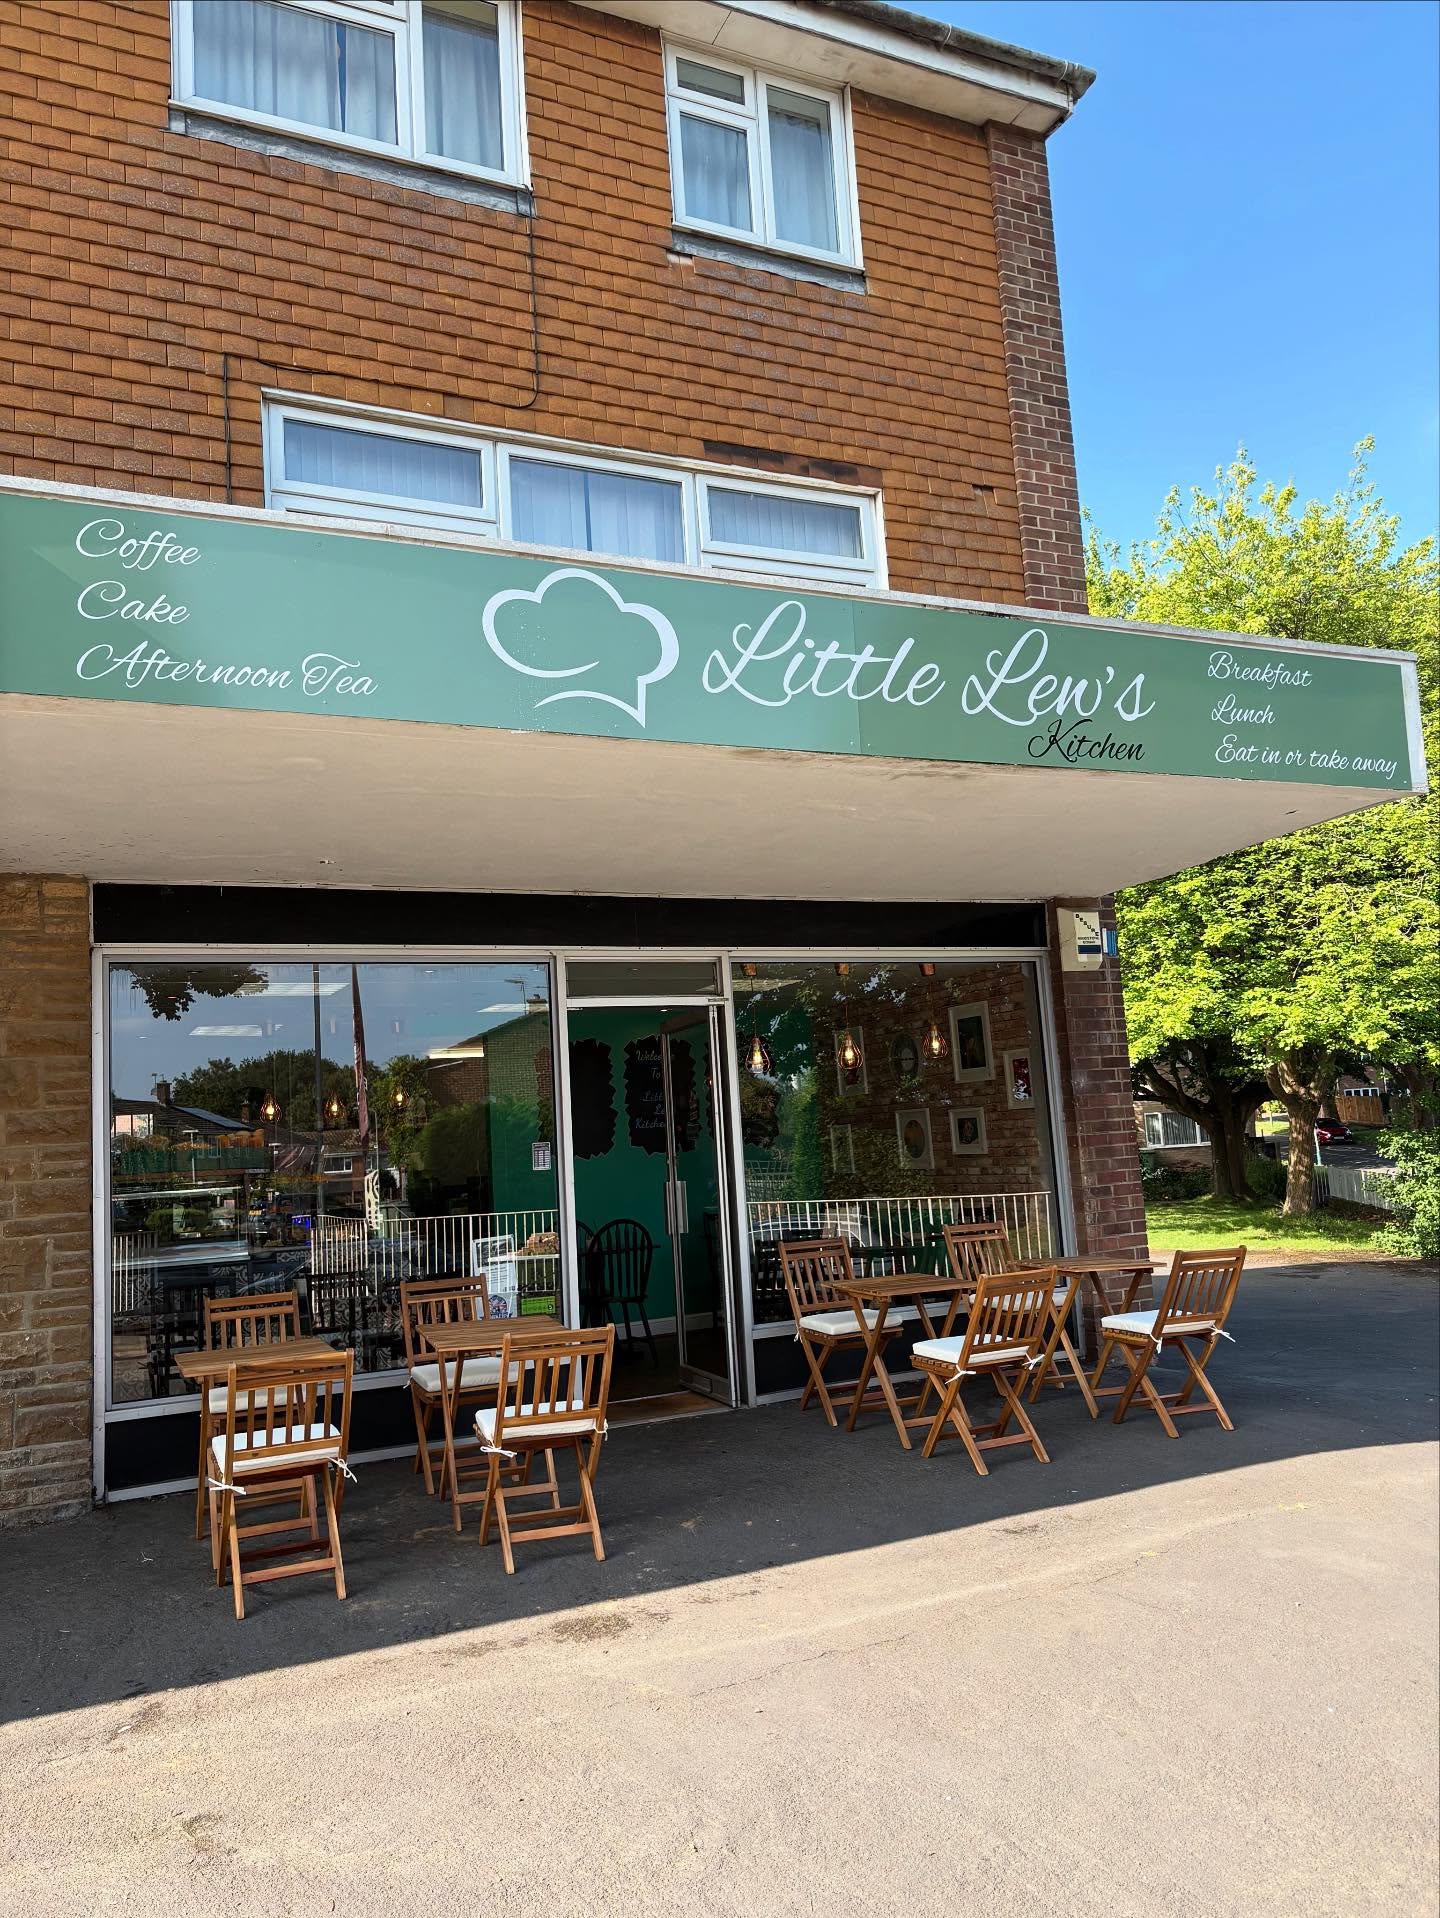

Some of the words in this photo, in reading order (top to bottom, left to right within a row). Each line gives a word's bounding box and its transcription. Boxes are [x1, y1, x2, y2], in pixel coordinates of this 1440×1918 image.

[75, 518, 202, 571] Coffee
[77, 580, 191, 624] Cake
[75, 640, 293, 689] Afternoon
[301, 652, 379, 697] Tea
[701, 600, 946, 707] Little
[961, 628, 1156, 727] Lew's
[1207, 650, 1313, 690] Breakfast
[1211, 693, 1276, 725] Lunch
[1027, 718, 1146, 763] Kitchen
[1214, 733, 1260, 763] Eat
[1261, 746, 1282, 765] in
[1285, 749, 1306, 767] or
[1309, 749, 1350, 770] take
[1352, 756, 1398, 780] away
[635, 1118, 666, 1129] Kitche
